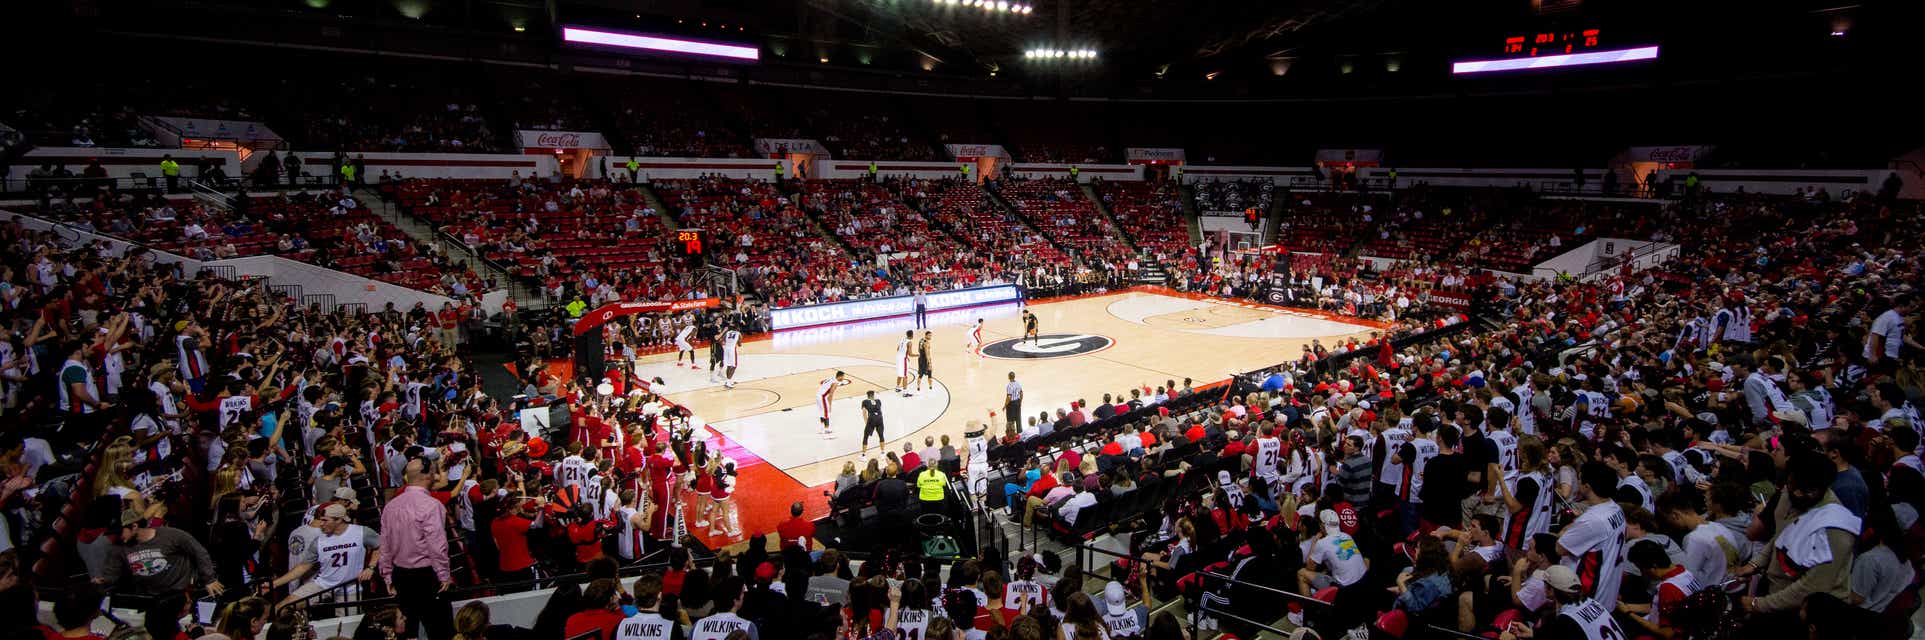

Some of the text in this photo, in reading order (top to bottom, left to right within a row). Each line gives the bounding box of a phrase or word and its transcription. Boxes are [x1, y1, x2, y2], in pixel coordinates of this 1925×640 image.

[687, 240, 702, 254] 19
[791, 306, 845, 322] KOCH
[1264, 450, 1278, 466] 21
[566, 466, 578, 481] 21
[322, 542, 357, 553] GEORGIA
[331, 551, 349, 568] 21
[624, 623, 663, 638] WILKINS
[1105, 617, 1136, 632] WILKINS
